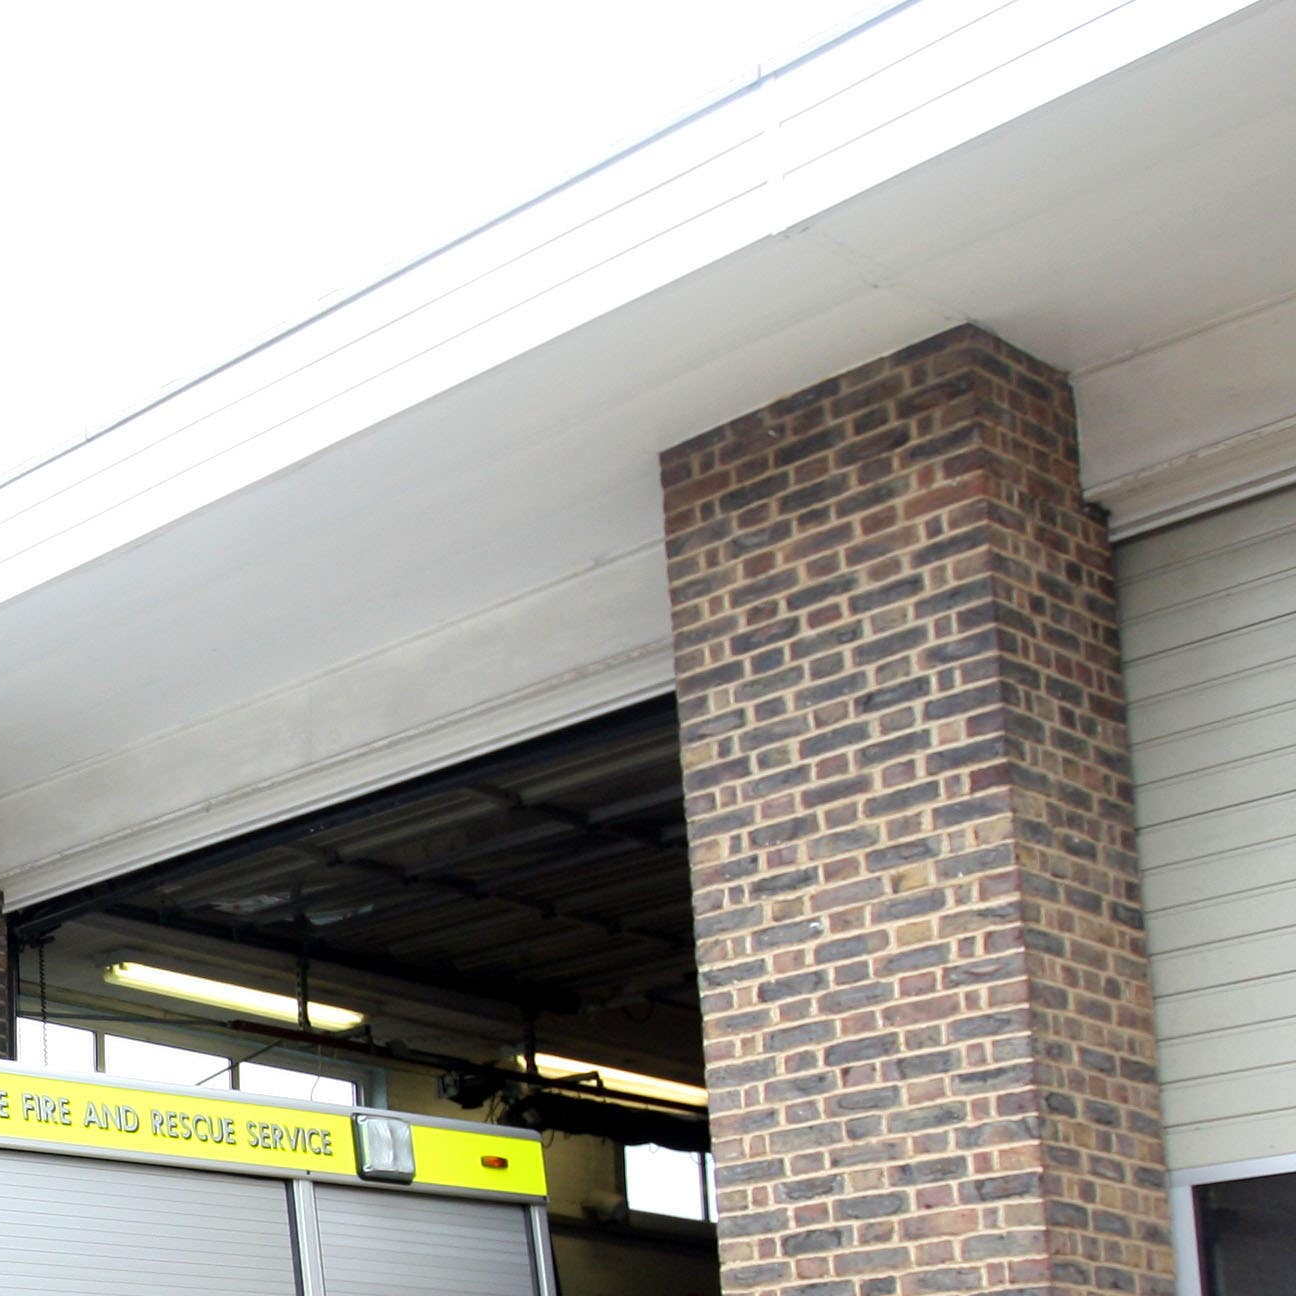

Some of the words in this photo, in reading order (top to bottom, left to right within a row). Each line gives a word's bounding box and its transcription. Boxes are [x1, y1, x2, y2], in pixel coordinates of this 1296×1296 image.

[21, 1093, 72, 1126] FIRE
[83, 1101, 139, 1133] AND
[151, 1109, 236, 1145] RESCUE
[246, 1120, 333, 1156] SERVICE
